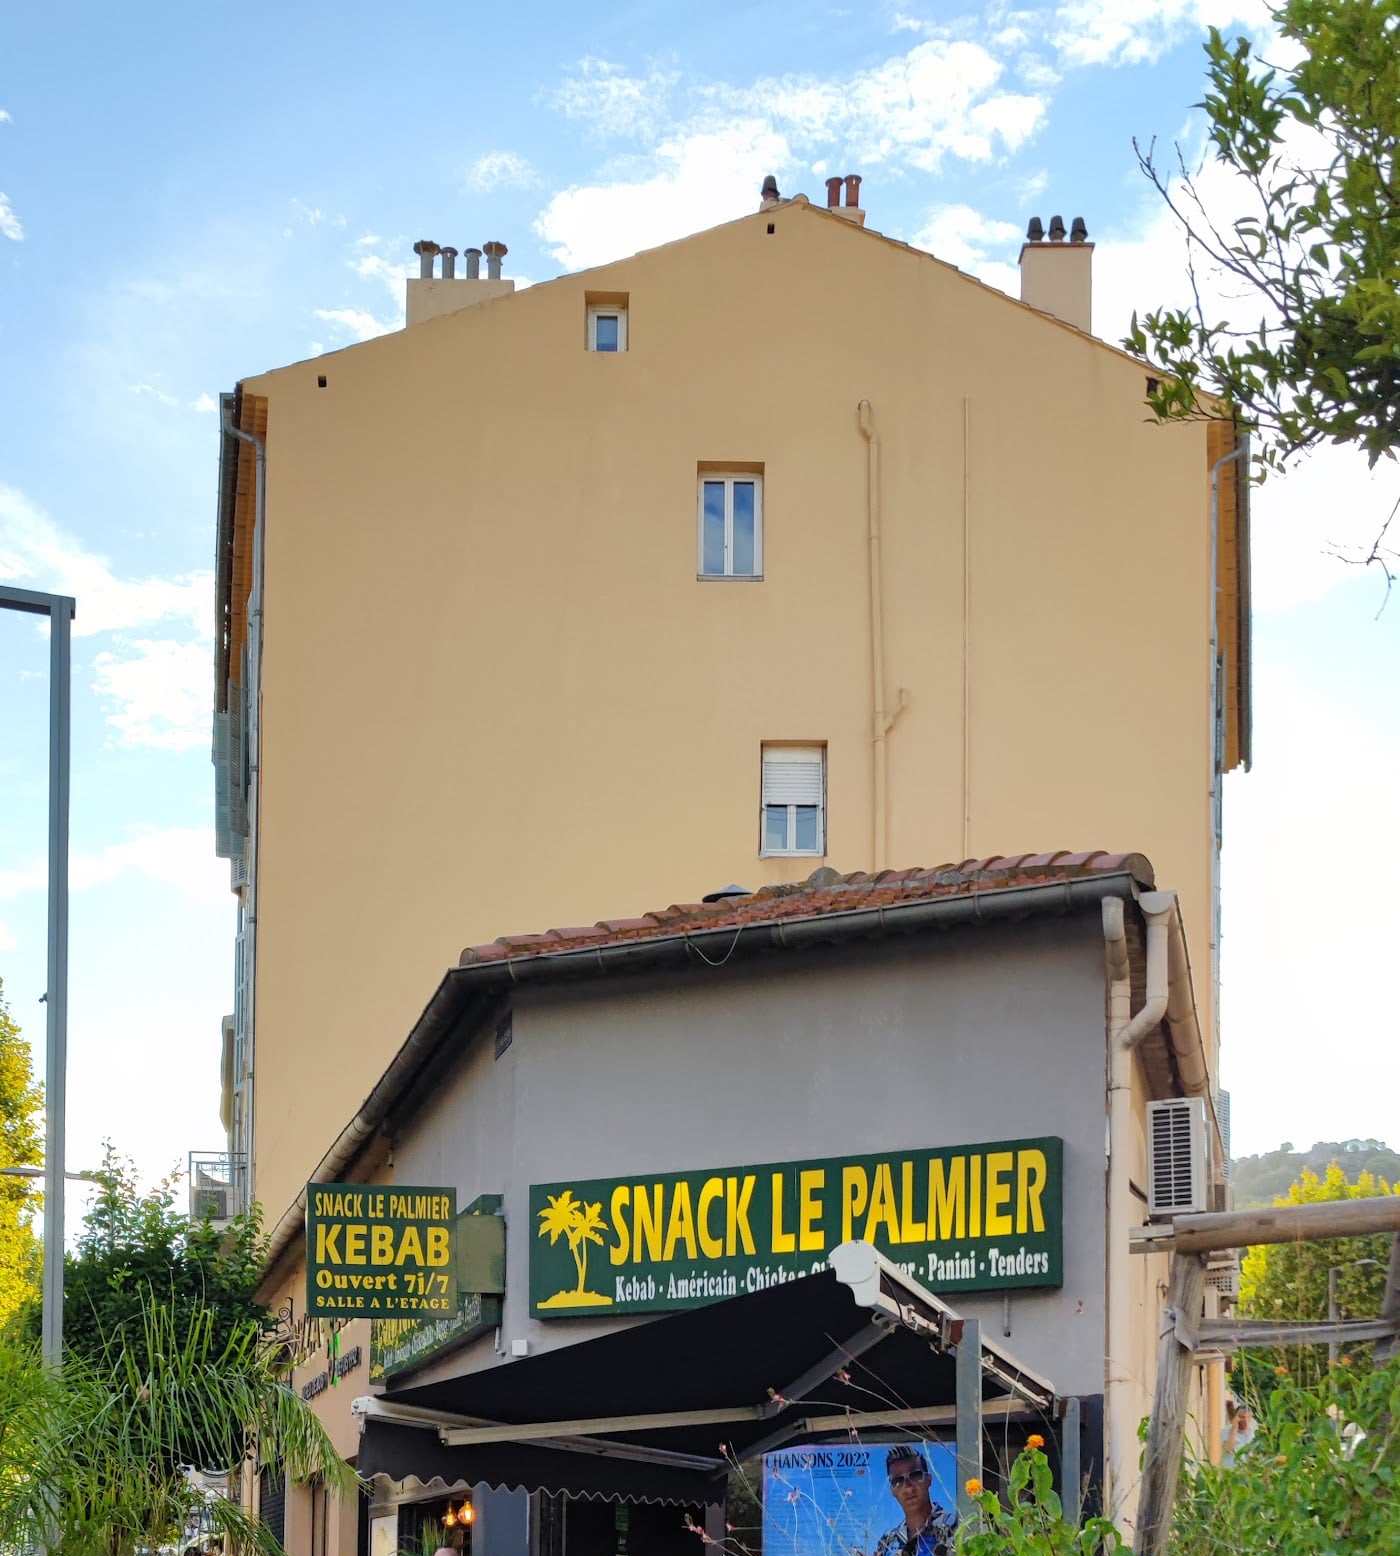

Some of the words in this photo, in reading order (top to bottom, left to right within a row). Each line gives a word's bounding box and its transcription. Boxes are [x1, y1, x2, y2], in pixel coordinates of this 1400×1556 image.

[315, 1192, 363, 1218] SNACK
[368, 1194, 384, 1219] LE
[389, 1194, 450, 1220] PALMIER
[610, 1174, 756, 1266] SNACK
[771, 1169, 825, 1254] LE
[842, 1148, 1048, 1246] PALMIER
[315, 1223, 450, 1267] KEBAB
[315, 1269, 397, 1291] Ouvert
[404, 1272, 450, 1296] 7j/7
[615, 1275, 656, 1303] Kebab
[666, 1268, 737, 1300] Américain
[927, 1250, 976, 1281] Panini
[988, 1246, 1049, 1278] Tenders
[315, 1296, 365, 1308] SALLE
[370, 1296, 381, 1309] A
[386, 1296, 450, 1310] L'ETAGE
[765, 1452, 834, 1469] CHANSONS
[837, 1451, 871, 1468] 2022
